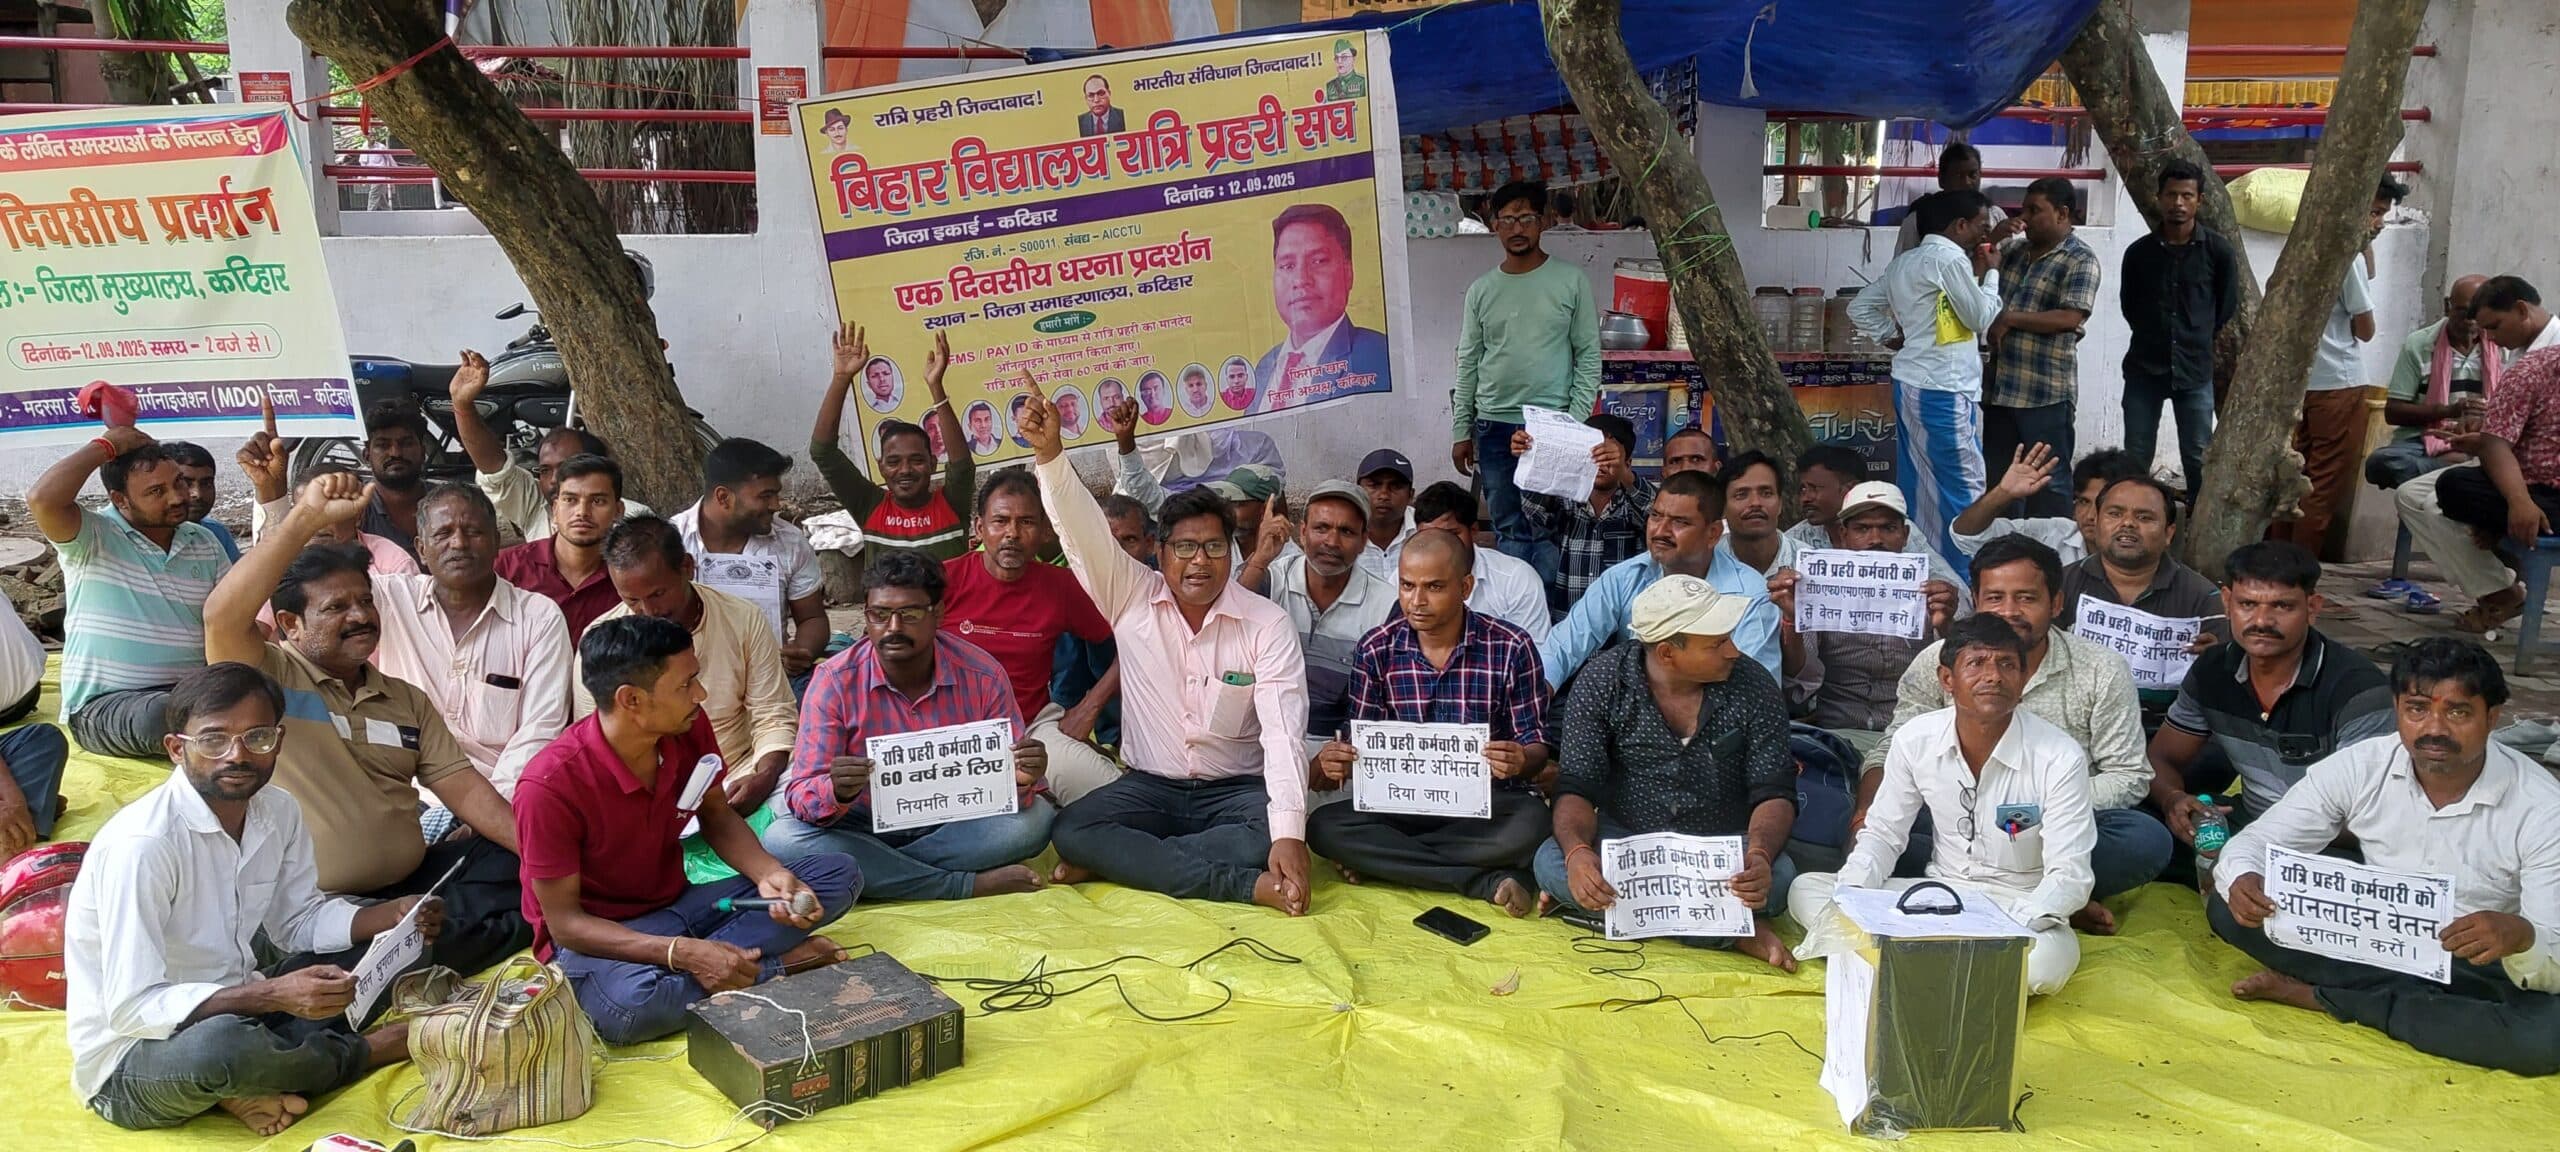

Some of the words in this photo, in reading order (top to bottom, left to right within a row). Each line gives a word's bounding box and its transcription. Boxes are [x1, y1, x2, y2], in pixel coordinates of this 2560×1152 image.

[1134, 71, 1185, 92] भारतीय
[1188, 64, 1242, 85] संविधान
[1246, 52, 1323, 76] जिन्दाबाद!!
[874, 106, 909, 127] रात्रि
[912, 100, 953, 124] प्रहरी
[956, 90, 1043, 115] जिन्दाबाद!
[19, 134, 65, 160] लंबित
[68, 127, 149, 157] समस्याओं
[150, 126, 170, 150] के
[170, 123, 228, 148] निदान
[228, 122, 261, 154] हेतु
[830, 153, 948, 215] बिहार
[951, 137, 1109, 197] विद्यालय
[1114, 110, 1191, 174] रात्रि
[1197, 95, 1286, 171] प्रहरी
[1292, 88, 1357, 147] संघ
[1163, 184, 1216, 206] दिनांक
[1228, 172, 1296, 195] 12.09.2025
[0, 187, 149, 250] दिवसीय
[147, 175, 281, 245] प्रदर्शन
[884, 228, 930, 247] जिला
[933, 215, 980, 241] इकाई
[996, 208, 1059, 230] कटिहार
[1102, 224, 1142, 240] AICCTU
[36, 265, 96, 303] जिला
[99, 269, 206, 315] मुख्यालय,
[204, 255, 290, 295] कटिहार
[894, 280, 944, 312] एक
[949, 257, 1053, 301] दिवसीय
[1057, 251, 1124, 283] धरना
[1128, 231, 1213, 279] प्रदर्शन
[924, 311, 965, 331] स्थान
[983, 299, 1026, 321] जिला
[1029, 284, 1134, 314] समाहरणालय,
[1137, 275, 1194, 295] कटिहार
[1039, 316, 1061, 331] हमारी
[150, 340, 189, 356] समय
[214, 332, 241, 352] बजे
[948, 351, 976, 366] FMS
[986, 344, 1011, 359] PAY
[1015, 342, 1029, 354] ID
[1031, 337, 1043, 350] के
[1045, 334, 1079, 348] माध्यम
[1081, 330, 1091, 342] से
[1094, 326, 1115, 340] रात्रि
[1116, 322, 1139, 337] प्रहरी
[1141, 321, 1156, 332] का
[1158, 314, 1192, 329] मानदेय
[1047, 350, 1084, 368] भुगतान
[1086, 345, 1112, 359] किया
[984, 378, 1006, 391] रात्रि
[1009, 376, 1027, 388] प्रह
[1034, 371, 1049, 383] की
[1053, 367, 1073, 381] सेवा
[1077, 367, 1091, 377] 60
[1112, 357, 1127, 370] की
[22, 398, 68, 418] मदरसा
[136, 386, 208, 412] र्गनाइजेशन
[267, 383, 301, 408] जिला
[1267, 387, 1295, 403] जिला
[885, 515, 931, 528] MODERN
[1808, 559, 1828, 577] रात्रि
[1831, 560, 1855, 579] प्रहरी
[1858, 561, 1899, 580] कर्मचारी
[1902, 564, 1917, 581] को
[1878, 584, 1888, 597] के
[1819, 603, 1843, 620] वेतन
[1848, 610, 1884, 626] भुगतान
[2087, 610, 2106, 627] रात्रि
[2108, 616, 2133, 633] प्रहरी
[2134, 623, 2174, 642] कर्मचारी
[2176, 628, 2193, 643] को
[2081, 628, 2113, 647] सरक्षा
[2114, 633, 2139, 656] कीट
[881, 745, 904, 767] रात्रि
[907, 741, 935, 764] प्रहरी
[937, 734, 982, 758] कर्मचारी
[985, 732, 1001, 751] को
[1366, 732, 1387, 750] रात्रि
[1390, 733, 1414, 751] प्रहरी
[1418, 733, 1460, 753] कर्मचारी
[1463, 735, 1479, 754] को
[881, 771, 903, 787] 60
[909, 763, 939, 784] वर्ष
[942, 761, 963, 778] के
[967, 757, 1004, 776] लिए
[1363, 756, 1397, 779] सुरक्षा
[1400, 752, 1426, 774] कीट
[1431, 754, 1481, 778] अभिलंब
[897, 793, 949, 816] नियमति
[1388, 783, 1416, 801] दिया
[1617, 848, 1637, 871] रात्रि
[1640, 845, 1667, 867] प्रहरी
[1669, 847, 1710, 869] कर्मचारी
[1713, 849, 1731, 869] को
[1617, 866, 1693, 900] ऑनलाईन
[2280, 863, 2308, 885] रात्रि
[2312, 871, 2345, 893] प्रहरी
[2350, 878, 2410, 905] कर्मचारी
[2414, 886, 2437, 909] को
[1632, 905, 1680, 928] भुगतान
[2277, 889, 2380, 931] ऑनलाईन
[2388, 904, 2440, 940] वेतन
[2297, 925, 2360, 949] भुगतान
[375, 942, 402, 982] भुगतान
